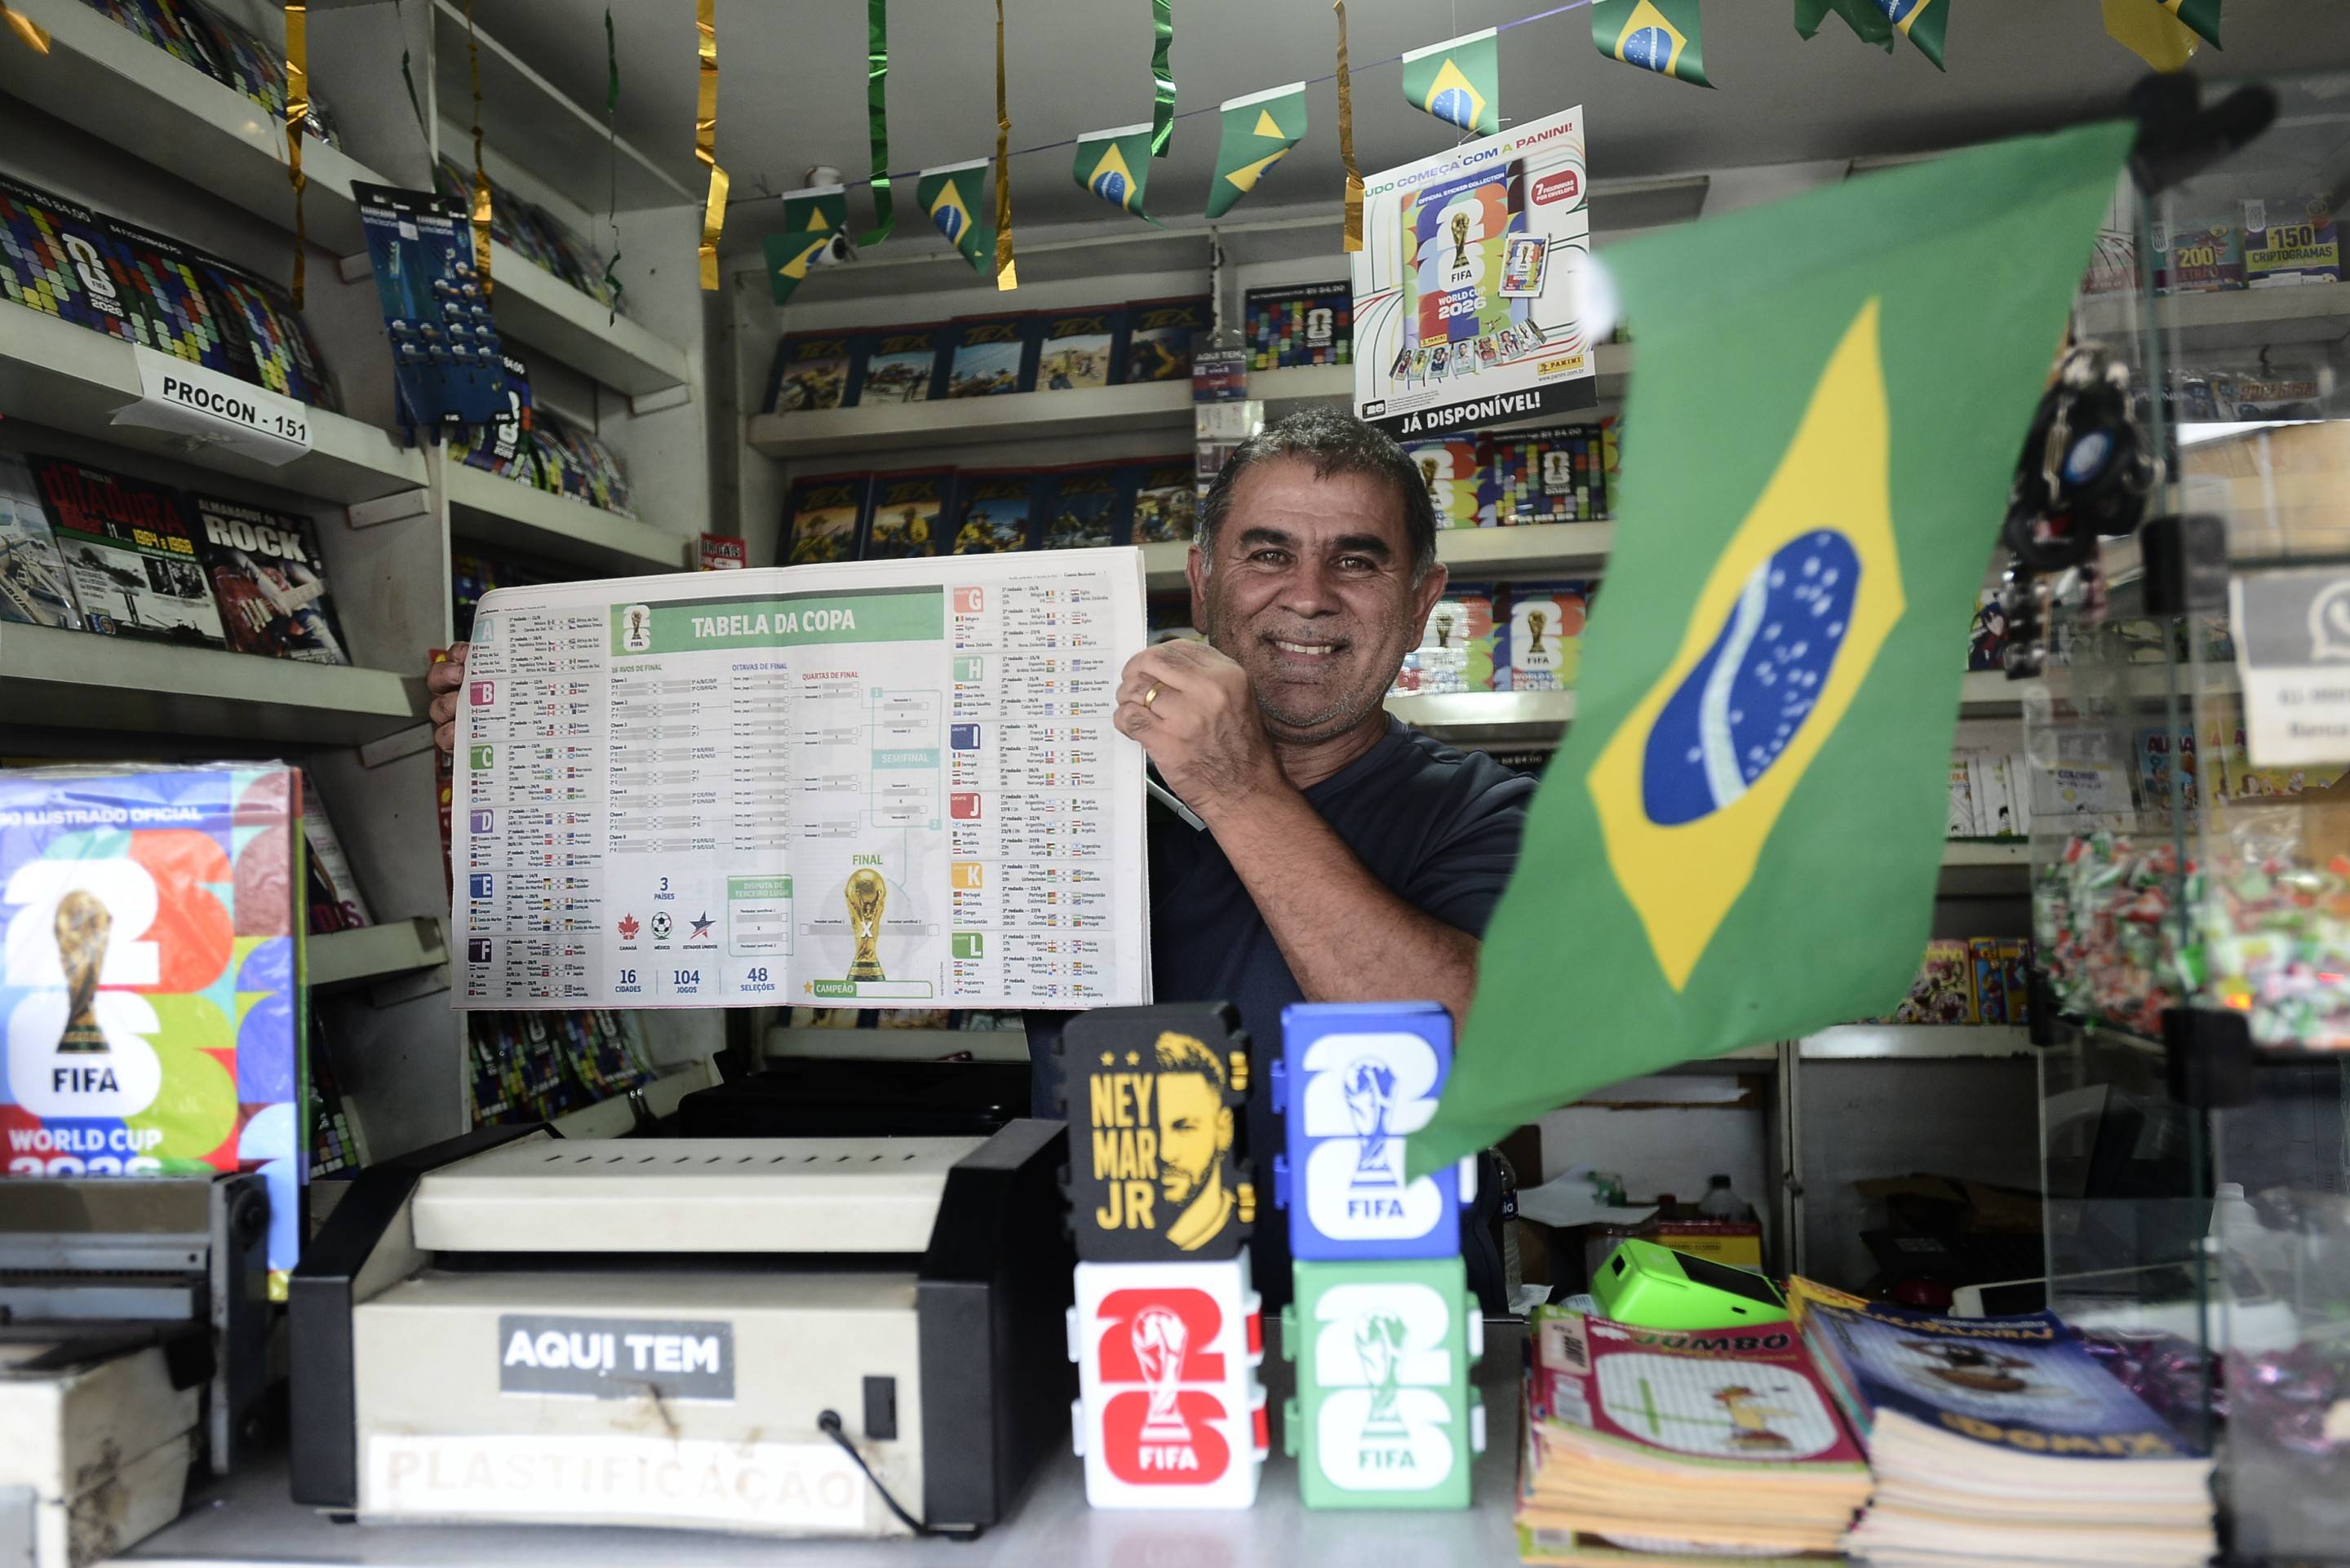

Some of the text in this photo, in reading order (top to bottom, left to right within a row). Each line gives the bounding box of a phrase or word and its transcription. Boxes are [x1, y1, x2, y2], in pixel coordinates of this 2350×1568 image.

[1364, 122, 1573, 197] UDO COMEÇA COM A PANINI!
[1418, 172, 1505, 205] OFFICIAL STICKER COLLECTION
[1536, 183, 1544, 195] 7
[1548, 186, 1575, 199] ENVELOPE
[2177, 247, 2215, 268] 200
[2251, 246, 2333, 264] CRIPTOGRAMAS
[1451, 270, 1473, 283] FIFA
[1439, 286, 1486, 305] WORLD CUP
[91, 299, 124, 317] 2026
[1439, 296, 1487, 320] 2026
[1427, 335, 1448, 344] PANINI
[1549, 357, 1582, 370] PANINI
[1538, 369, 1585, 383] www.panini.com.br
[163, 376, 255, 424] PROCON
[275, 415, 306, 441] 151
[1401, 413, 1425, 434] JÁ
[1428, 391, 1541, 428] DISPONÍVEL!
[201, 512, 308, 564] ROCK
[969, 589, 982, 612] G
[482, 622, 493, 640] A
[691, 609, 856, 638] TABELA DA COPA
[644, 663, 663, 672] FINAL
[732, 663, 759, 671] OITAVAS
[802, 672, 830, 680] QUARTAS
[969, 658, 981, 680] H
[482, 684, 493, 703] B
[482, 747, 493, 768] C
[882, 753, 929, 764] SEMIFINAL
[970, 795, 979, 817] J
[24, 806, 203, 826] ILUSTRADO OFICIAL
[481, 812, 492, 831] D
[852, 854, 884, 866] FINAL
[660, 877, 669, 891] 3
[743, 881, 774, 890] DISPUTA
[968, 866, 981, 886] K
[482, 876, 491, 896] E
[735, 889, 769, 897] TERCEIRO
[654, 892, 675, 901] PAÍSES
[862, 920, 873, 938] X
[481, 941, 490, 960] F
[970, 935, 982, 956] L
[620, 969, 636, 984] 16
[673, 970, 700, 985] 104
[747, 968, 768, 982] 48
[740, 982, 775, 994] SELEÇÕES
[816, 981, 854, 994] CAMPEÃO
[52, 1067, 119, 1093] FIFA
[1090, 1074, 1154, 1128] NEY
[9, 1128, 163, 1152] WORLD CUP
[1093, 1128, 1159, 1180] MAR
[1095, 1180, 1156, 1230] JR
[1346, 1198, 1406, 1220] FIFA
[1633, 1332, 1792, 1352] JUMBO
[503, 1330, 721, 1374] AQUI TEM
[1138, 1446, 1199, 1471] FIFA
[1358, 1449, 1417, 1469] FIFA
[385, 1444, 859, 1515] PLASTIFICAÇÃO
